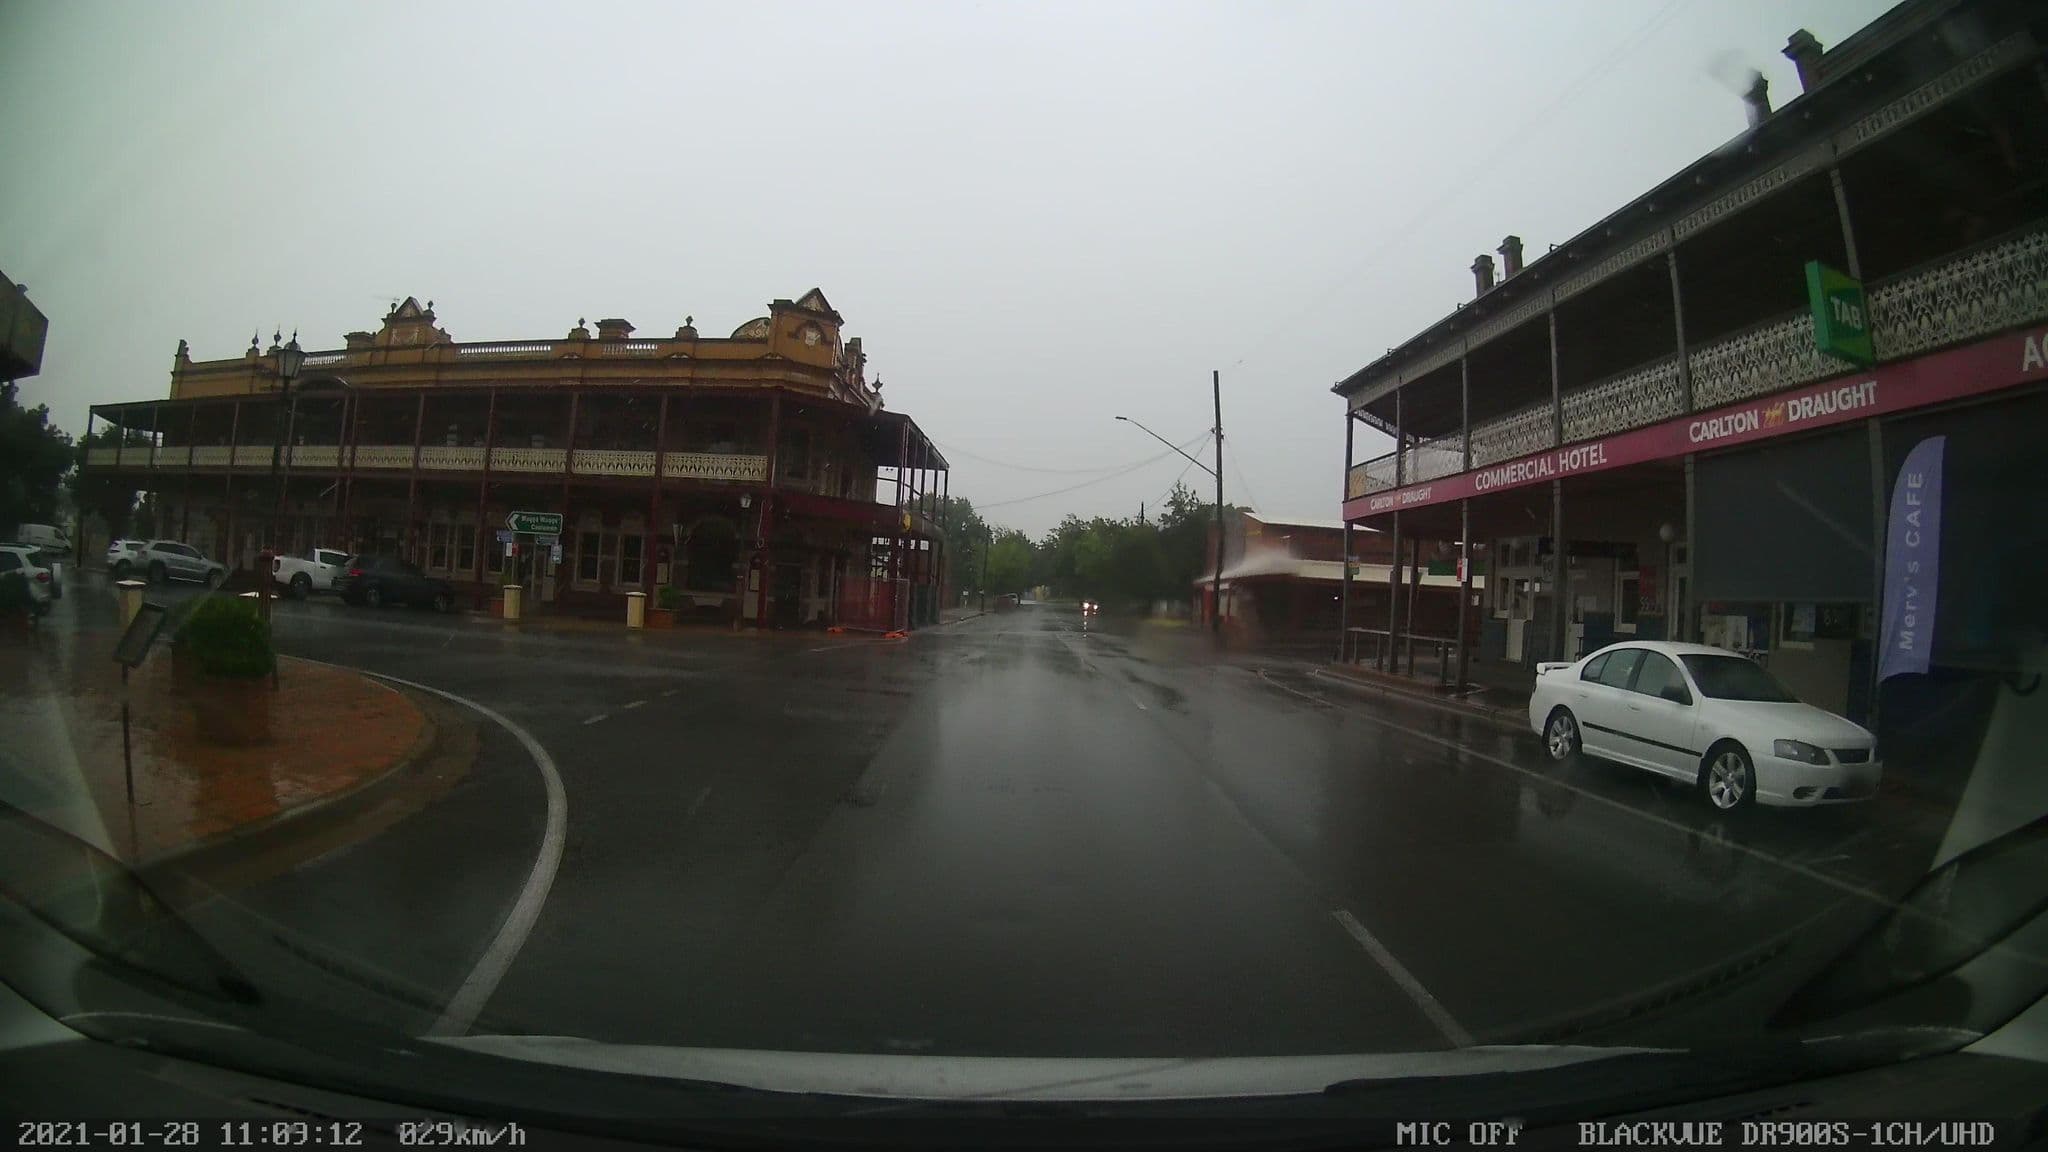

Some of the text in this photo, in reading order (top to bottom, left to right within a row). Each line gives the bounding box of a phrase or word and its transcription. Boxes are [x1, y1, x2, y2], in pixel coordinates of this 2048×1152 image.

[1831, 296, 1863, 330] TAB
[1689, 380, 1877, 444] CARLTON DRAUGHT
[1475, 443, 1608, 491] COMMERCIAL HOTEL
[1370, 487, 1432, 511] CARLTON DRAUGHT
[1905, 472, 1923, 549] CAFE
